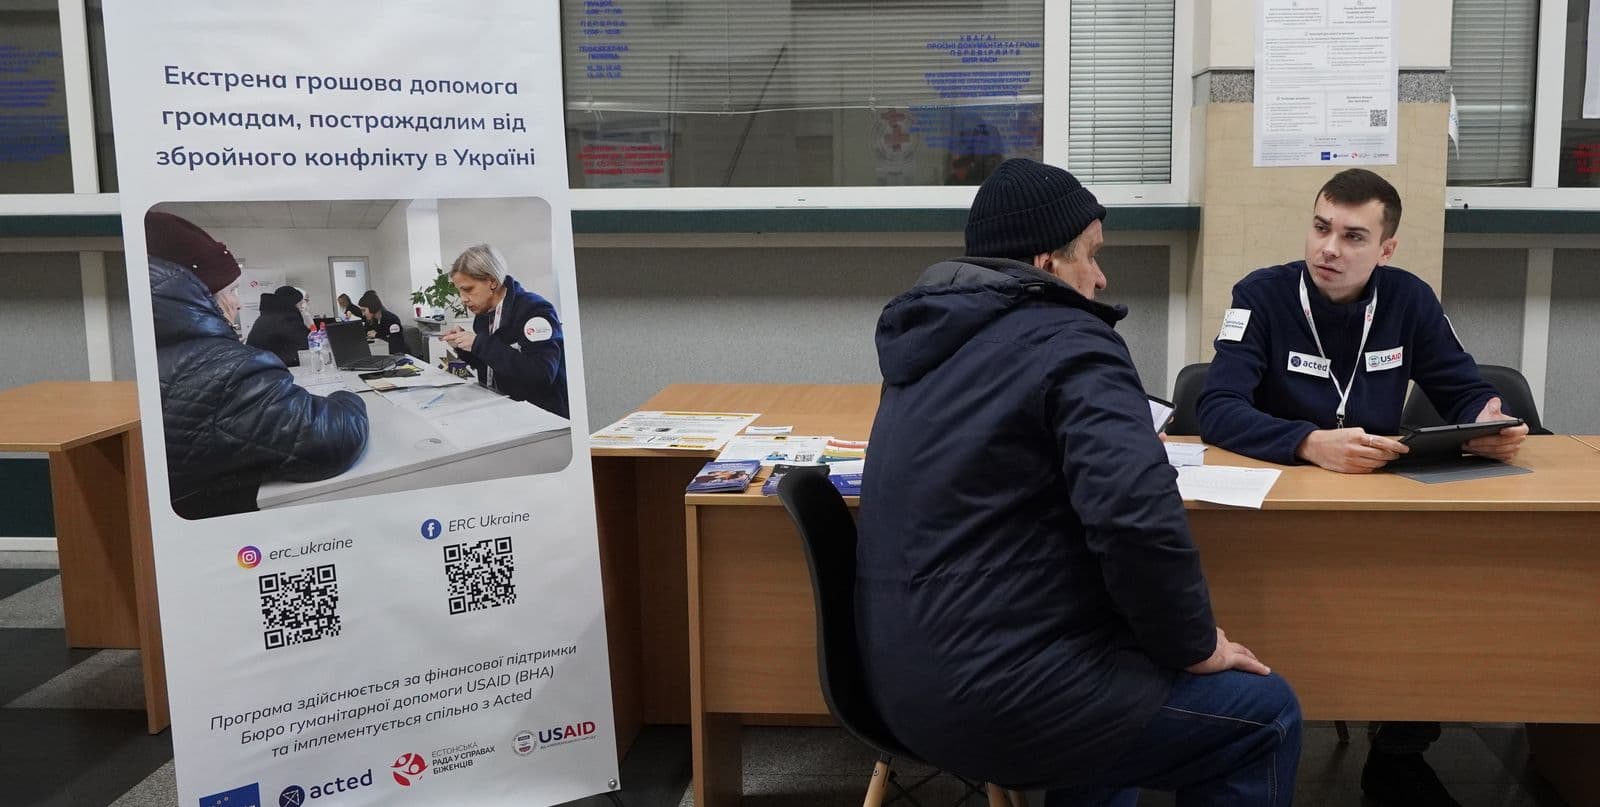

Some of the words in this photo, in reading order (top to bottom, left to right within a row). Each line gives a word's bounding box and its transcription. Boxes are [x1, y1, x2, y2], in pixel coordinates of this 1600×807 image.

[164, 65, 286, 92] Екстрена
[296, 76, 402, 94] грошова
[410, 79, 518, 95] допомога
[162, 111, 301, 130] громадам,
[310, 114, 485, 133] постраждалим
[493, 113, 526, 133] від
[156, 146, 296, 171] збройного
[305, 147, 428, 171] конфлікту
[435, 153, 447, 166] в
[453, 148, 535, 171] Україні
[1302, 360, 1329, 372] acted
[1380, 353, 1402, 363] USAID
[449, 517, 476, 532] ERC
[480, 512, 530, 527] Ukraine
[269, 538, 353, 560] erc_ukraine
[211, 702, 292, 731] Програма
[297, 679, 399, 710] здійснюється
[404, 675, 420, 687] за
[425, 656, 504, 685] фінансової
[506, 645, 577, 666] підтримки
[241, 725, 285, 744] Бюро
[290, 698, 390, 734] гуманітарної
[393, 686, 462, 711] допомоги
[467, 674, 511, 693] USAID
[515, 665, 554, 685] (BHA)
[271, 745, 289, 757] та
[294, 715, 421, 752] імплементується
[425, 702, 478, 722] спільно
[482, 700, 490, 709] з
[493, 688, 532, 707] Acted
[538, 721, 596, 743] USAID
[431, 742, 478, 758] ЕСТОНСЬКА
[432, 756, 453, 766] РАДА
[453, 753, 460, 763] У
[460, 745, 495, 759] СПРАВАХ
[433, 759, 473, 775] БІЖЕНЦІВ
[310, 768, 373, 799] acted
